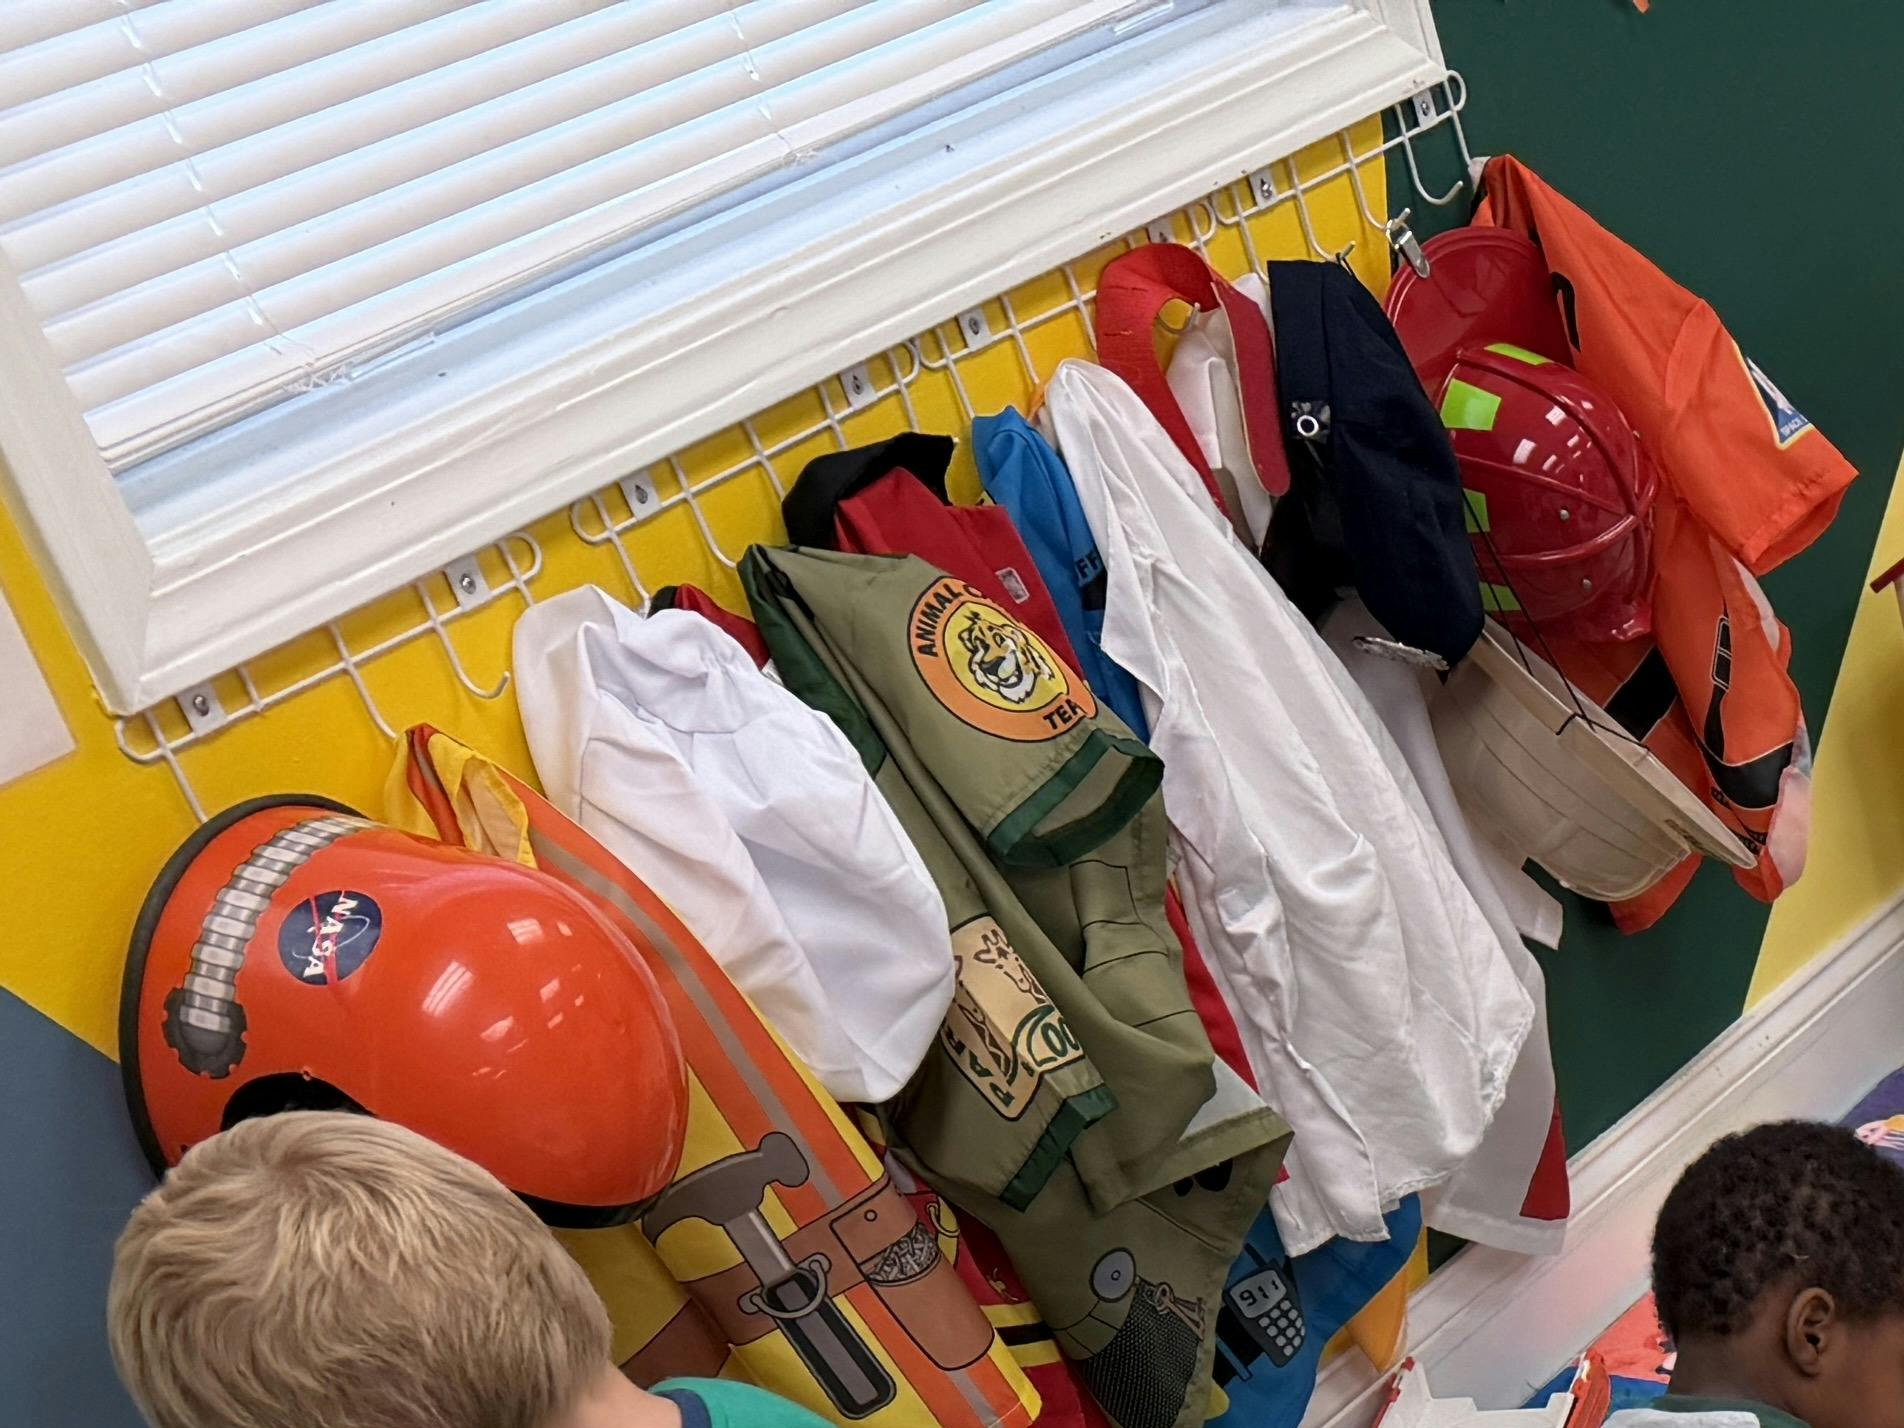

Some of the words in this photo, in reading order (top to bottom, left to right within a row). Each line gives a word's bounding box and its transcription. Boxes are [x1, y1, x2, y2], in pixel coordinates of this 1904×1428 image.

[915, 583, 961, 657] ANIMAL
[303, 896, 359, 978] NASA
[1239, 1279, 1279, 1307] 911
